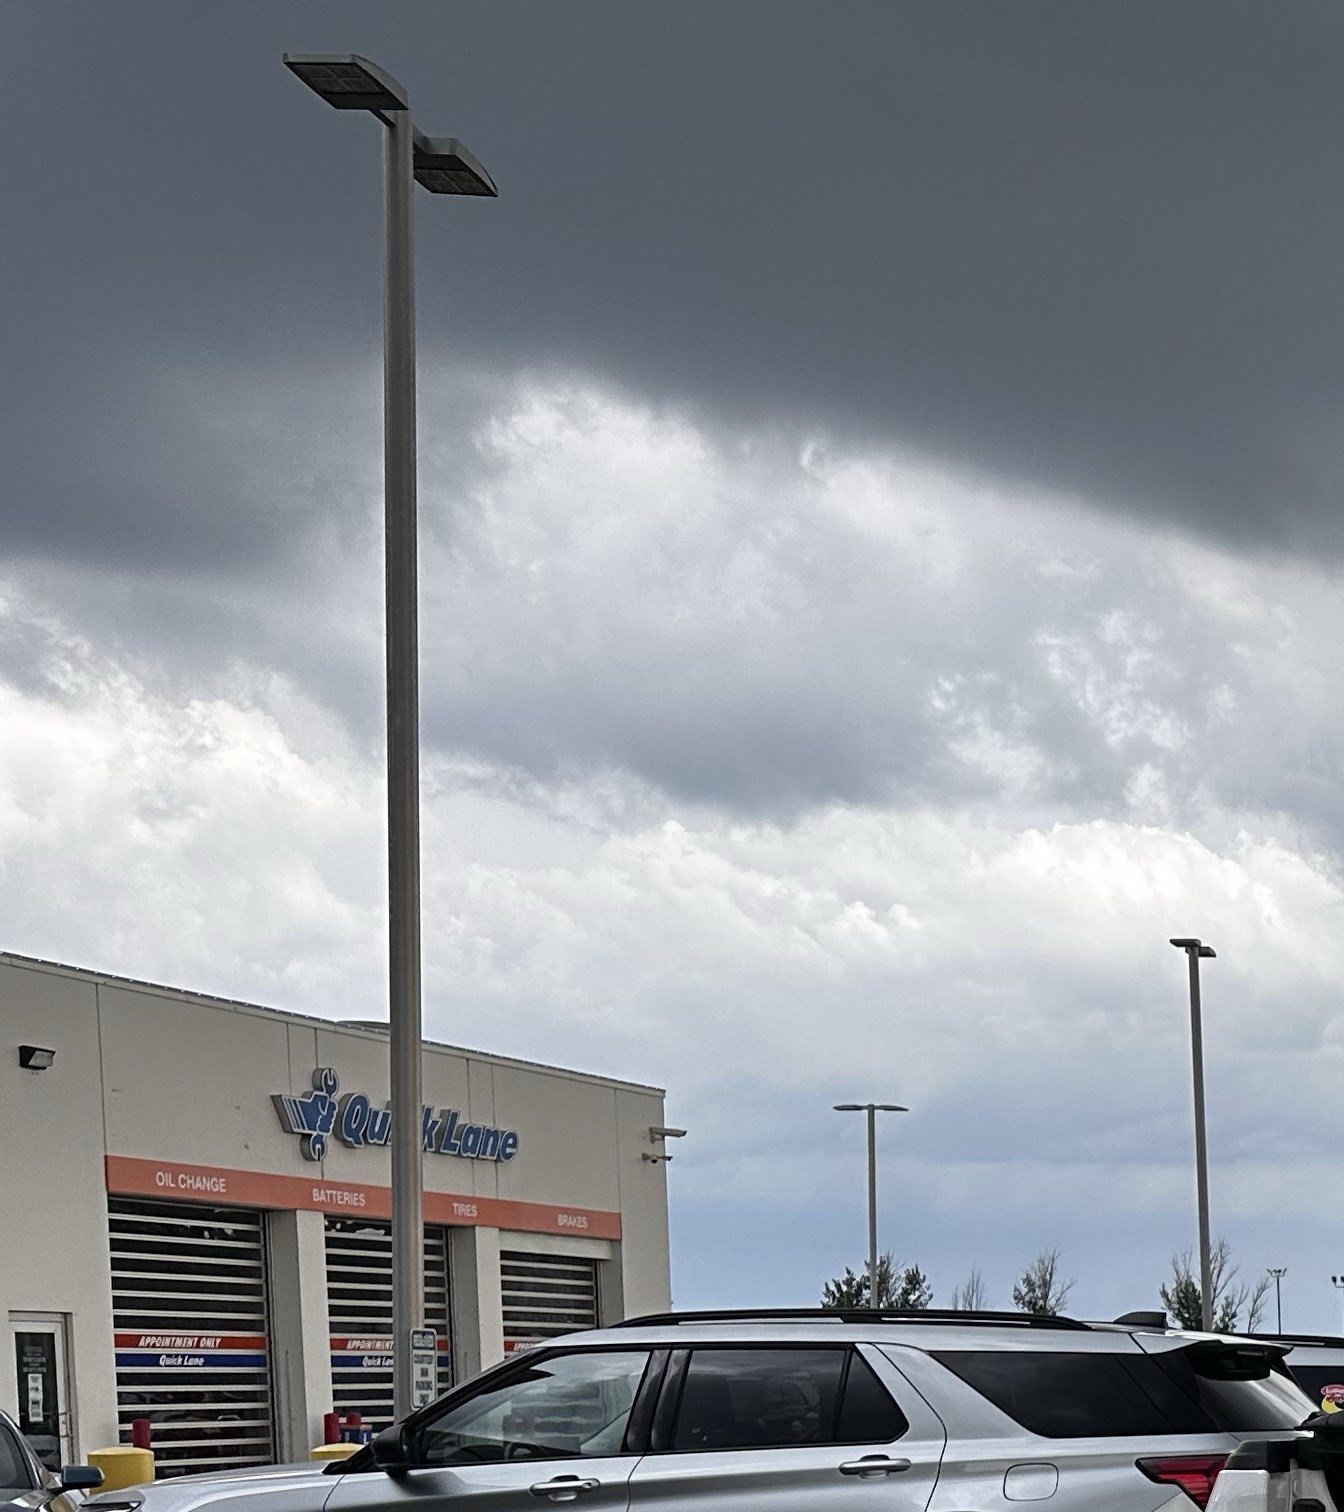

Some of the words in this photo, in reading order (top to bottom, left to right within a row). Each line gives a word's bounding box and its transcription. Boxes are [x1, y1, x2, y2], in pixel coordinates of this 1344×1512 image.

[341, 1093, 441, 1152] Quk
[440, 1107, 519, 1162] Lane
[155, 1171, 176, 1188] OIL
[177, 1173, 228, 1193] CHANGE
[311, 1187, 366, 1208] BATTERIES
[452, 1202, 478, 1218] TIRES
[557, 1213, 588, 1229] BRAKES
[138, 1336, 199, 1348] APPOINTMENT
[200, 1337, 221, 1349] ONLY
[159, 1354, 182, 1367] Quick
[183, 1355, 205, 1367] Lane
